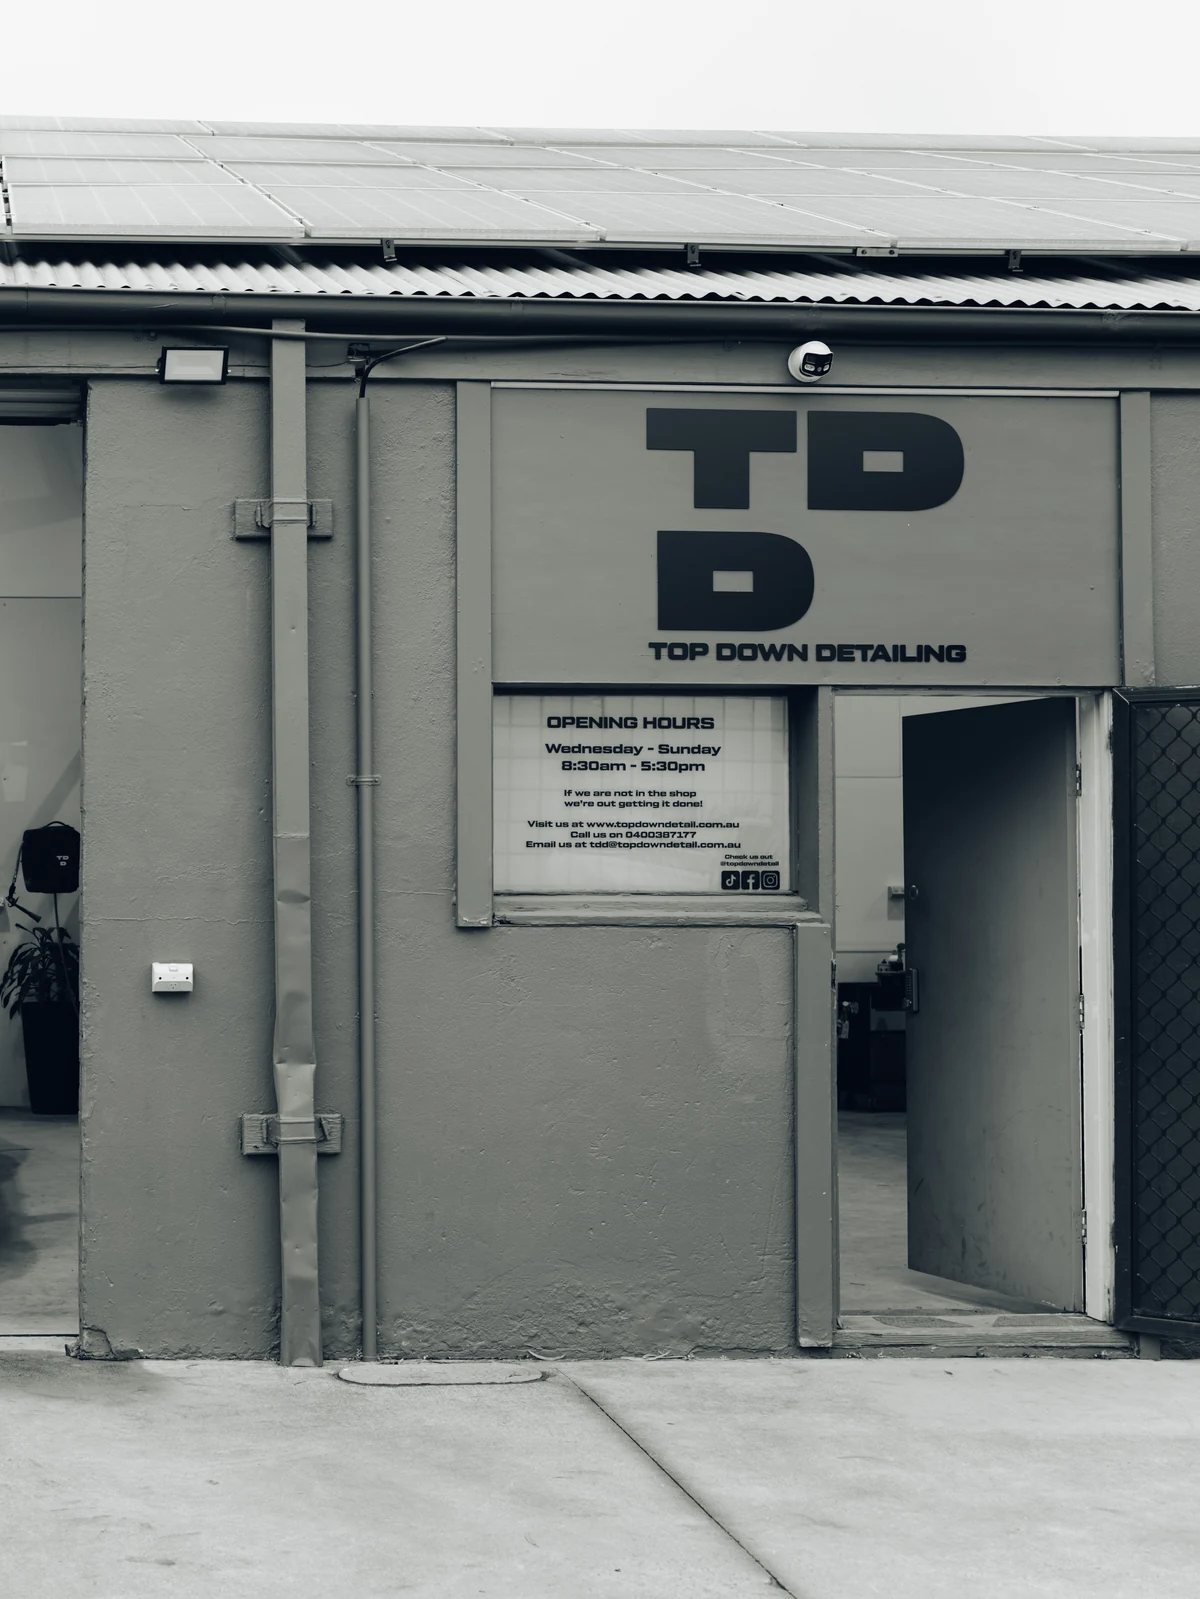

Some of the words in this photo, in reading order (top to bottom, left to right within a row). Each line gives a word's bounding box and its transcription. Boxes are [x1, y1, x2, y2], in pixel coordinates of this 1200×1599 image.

[646, 408, 965, 512] TD
[657, 530, 815, 632] D
[648, 642, 709, 661] TOP
[716, 643, 808, 662] DOWN
[815, 644, 967, 663] DETAILING
[546, 716, 638, 730] OPENING
[642, 716, 715, 730] HOURS
[544, 743, 644, 757] Wednesday
[657, 743, 722, 757] Sunday
[561, 760, 627, 771] 8:30am
[640, 760, 706, 774] 5:30pm
[563, 789, 573, 798] If
[574, 790, 591, 798] we
[592, 790, 612, 798] are
[613, 790, 634, 798] not
[635, 789, 646, 798] in
[647, 789, 667, 798] the
[669, 789, 697, 800] shop
[563, 799, 595, 808] we're
[596, 800, 617, 808] out
[618, 800, 660, 809] getting
[661, 800, 671, 808] it
[672, 800, 703, 808] done!
[527, 820, 554, 828] Visit
[571, 820, 584, 828] at
[586, 820, 740, 830] www.topdowndetail.com.au
[570, 831, 591, 839] Call
[625, 831, 697, 839] 0400387177
[525, 840, 556, 848] Email
[589, 840, 741, 850] tdd@topdowndetail.com.au
